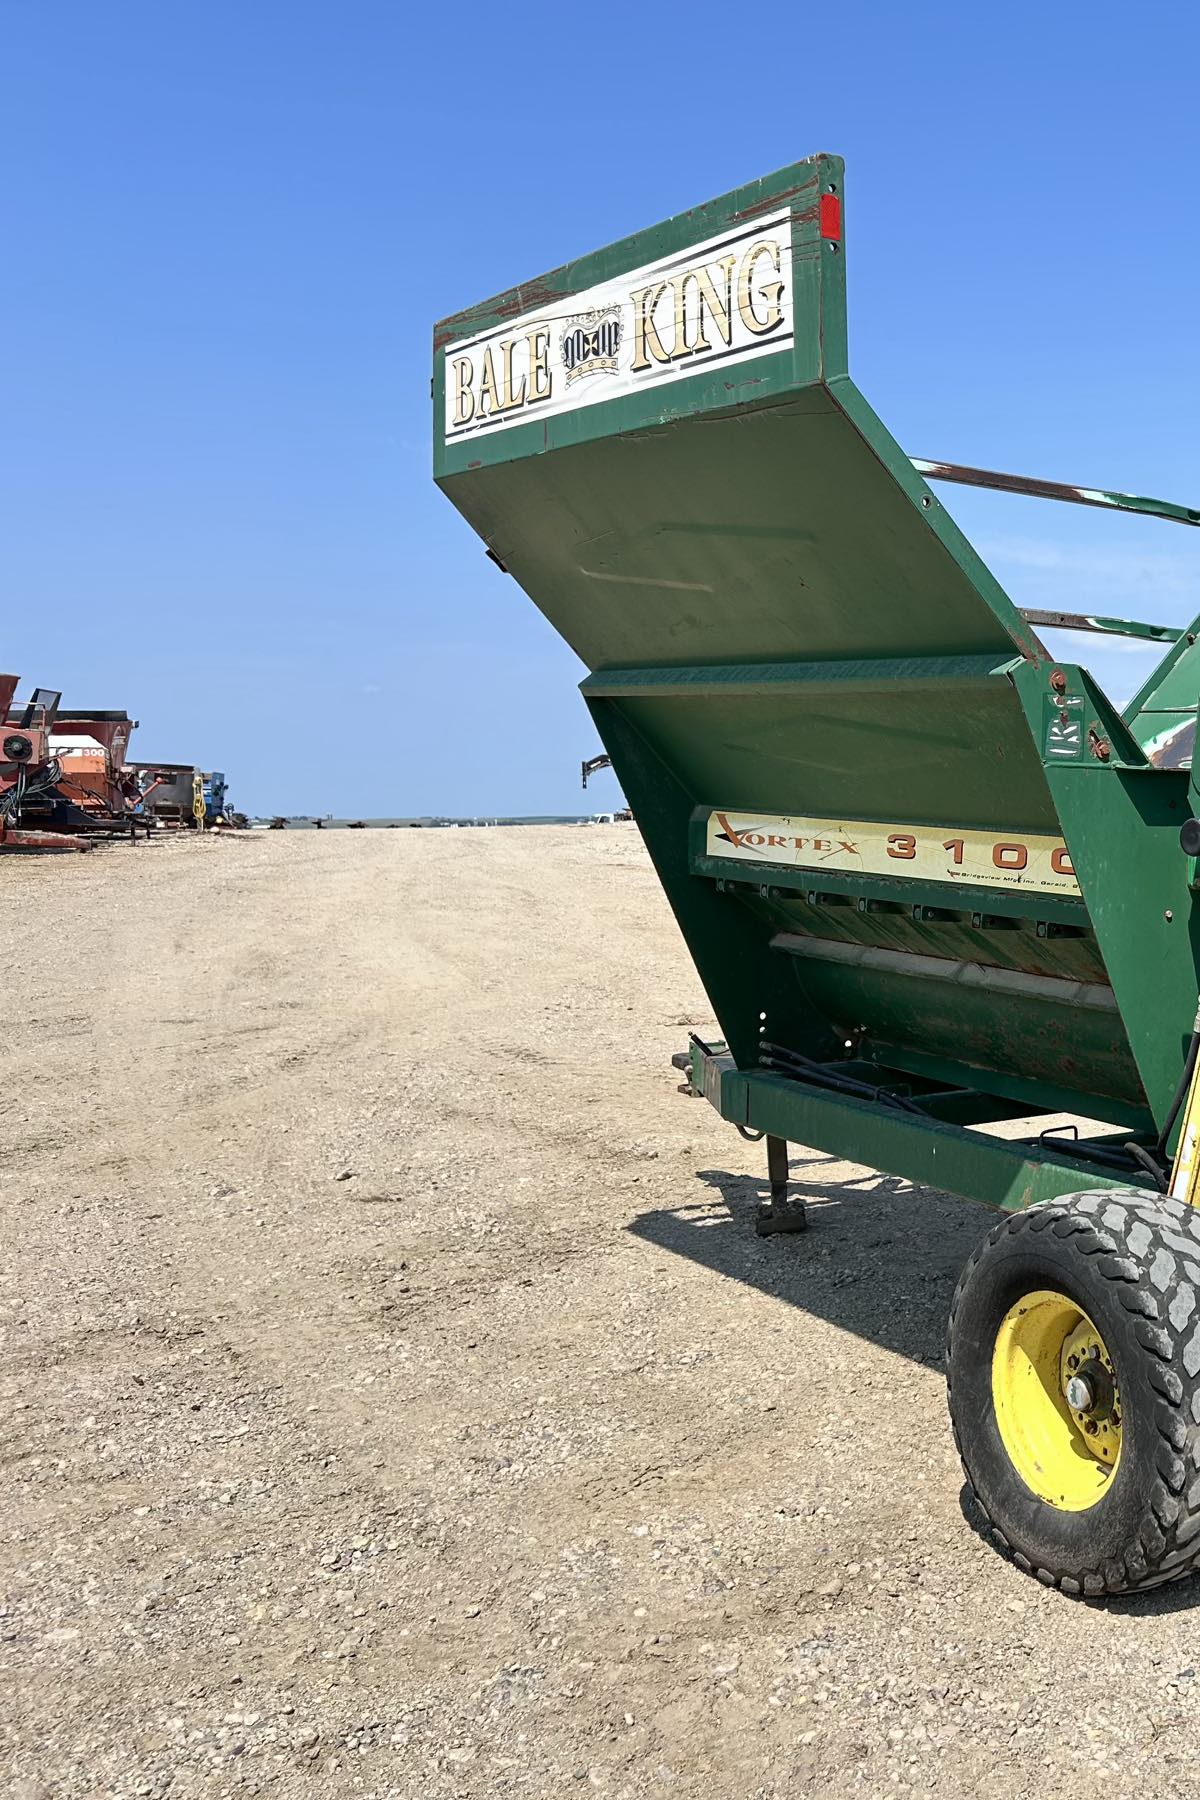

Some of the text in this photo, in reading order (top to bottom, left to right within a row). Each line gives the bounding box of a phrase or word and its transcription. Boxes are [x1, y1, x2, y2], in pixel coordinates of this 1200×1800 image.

[452, 239, 785, 426] BALE KING
[83, 748, 105, 757] 300
[715, 813, 861, 861] VORTEX
[961, 872, 1001, 881] Bridgeview
